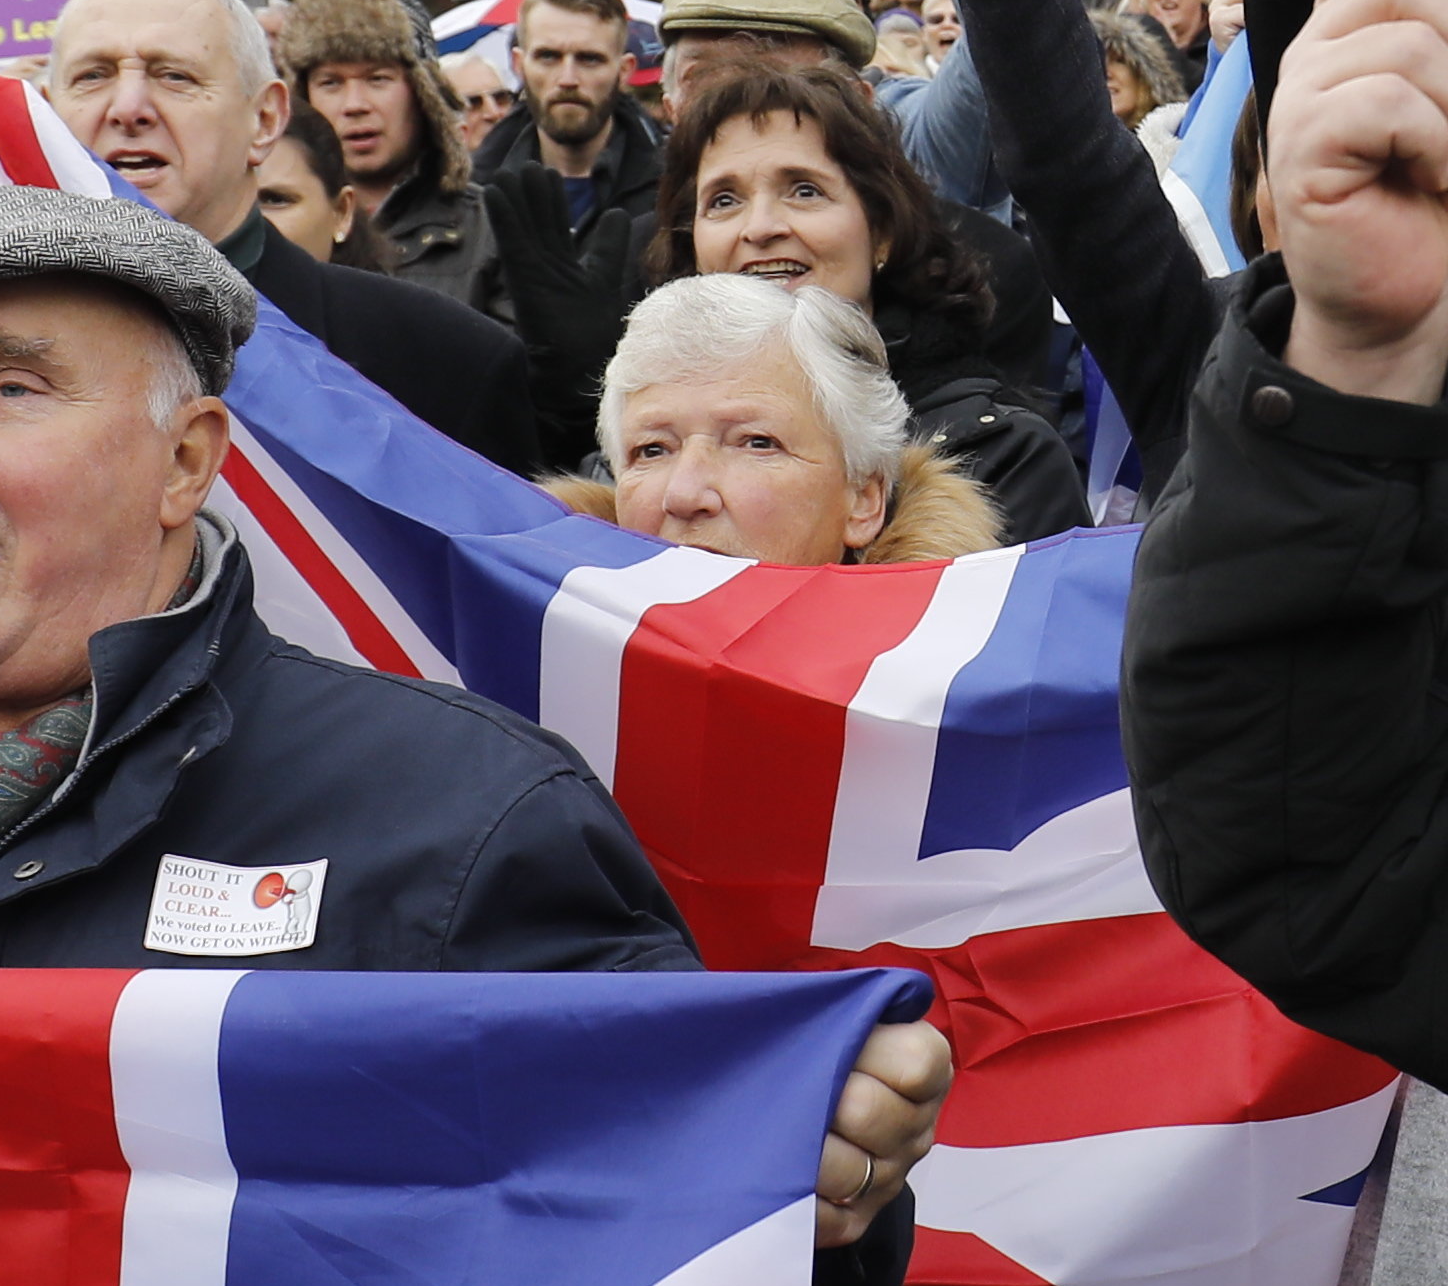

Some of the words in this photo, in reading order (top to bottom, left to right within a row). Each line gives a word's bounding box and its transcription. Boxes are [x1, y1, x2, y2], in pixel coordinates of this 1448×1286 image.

[12, 18, 57, 42] Lea
[163, 862, 219, 881] SHOUT
[226, 873, 243, 885] IT
[167, 881, 214, 898] LOUD
[217, 890, 230, 901] &
[164, 899, 232, 918] CLEAR...
[154, 915, 174, 927] We
[177, 920, 211, 933] voted
[214, 922, 226, 933] to
[150, 931, 187, 947] NOW
[190, 935, 221, 948] GET
[224, 936, 246, 949] ON
[249, 933, 285, 947] WITH
